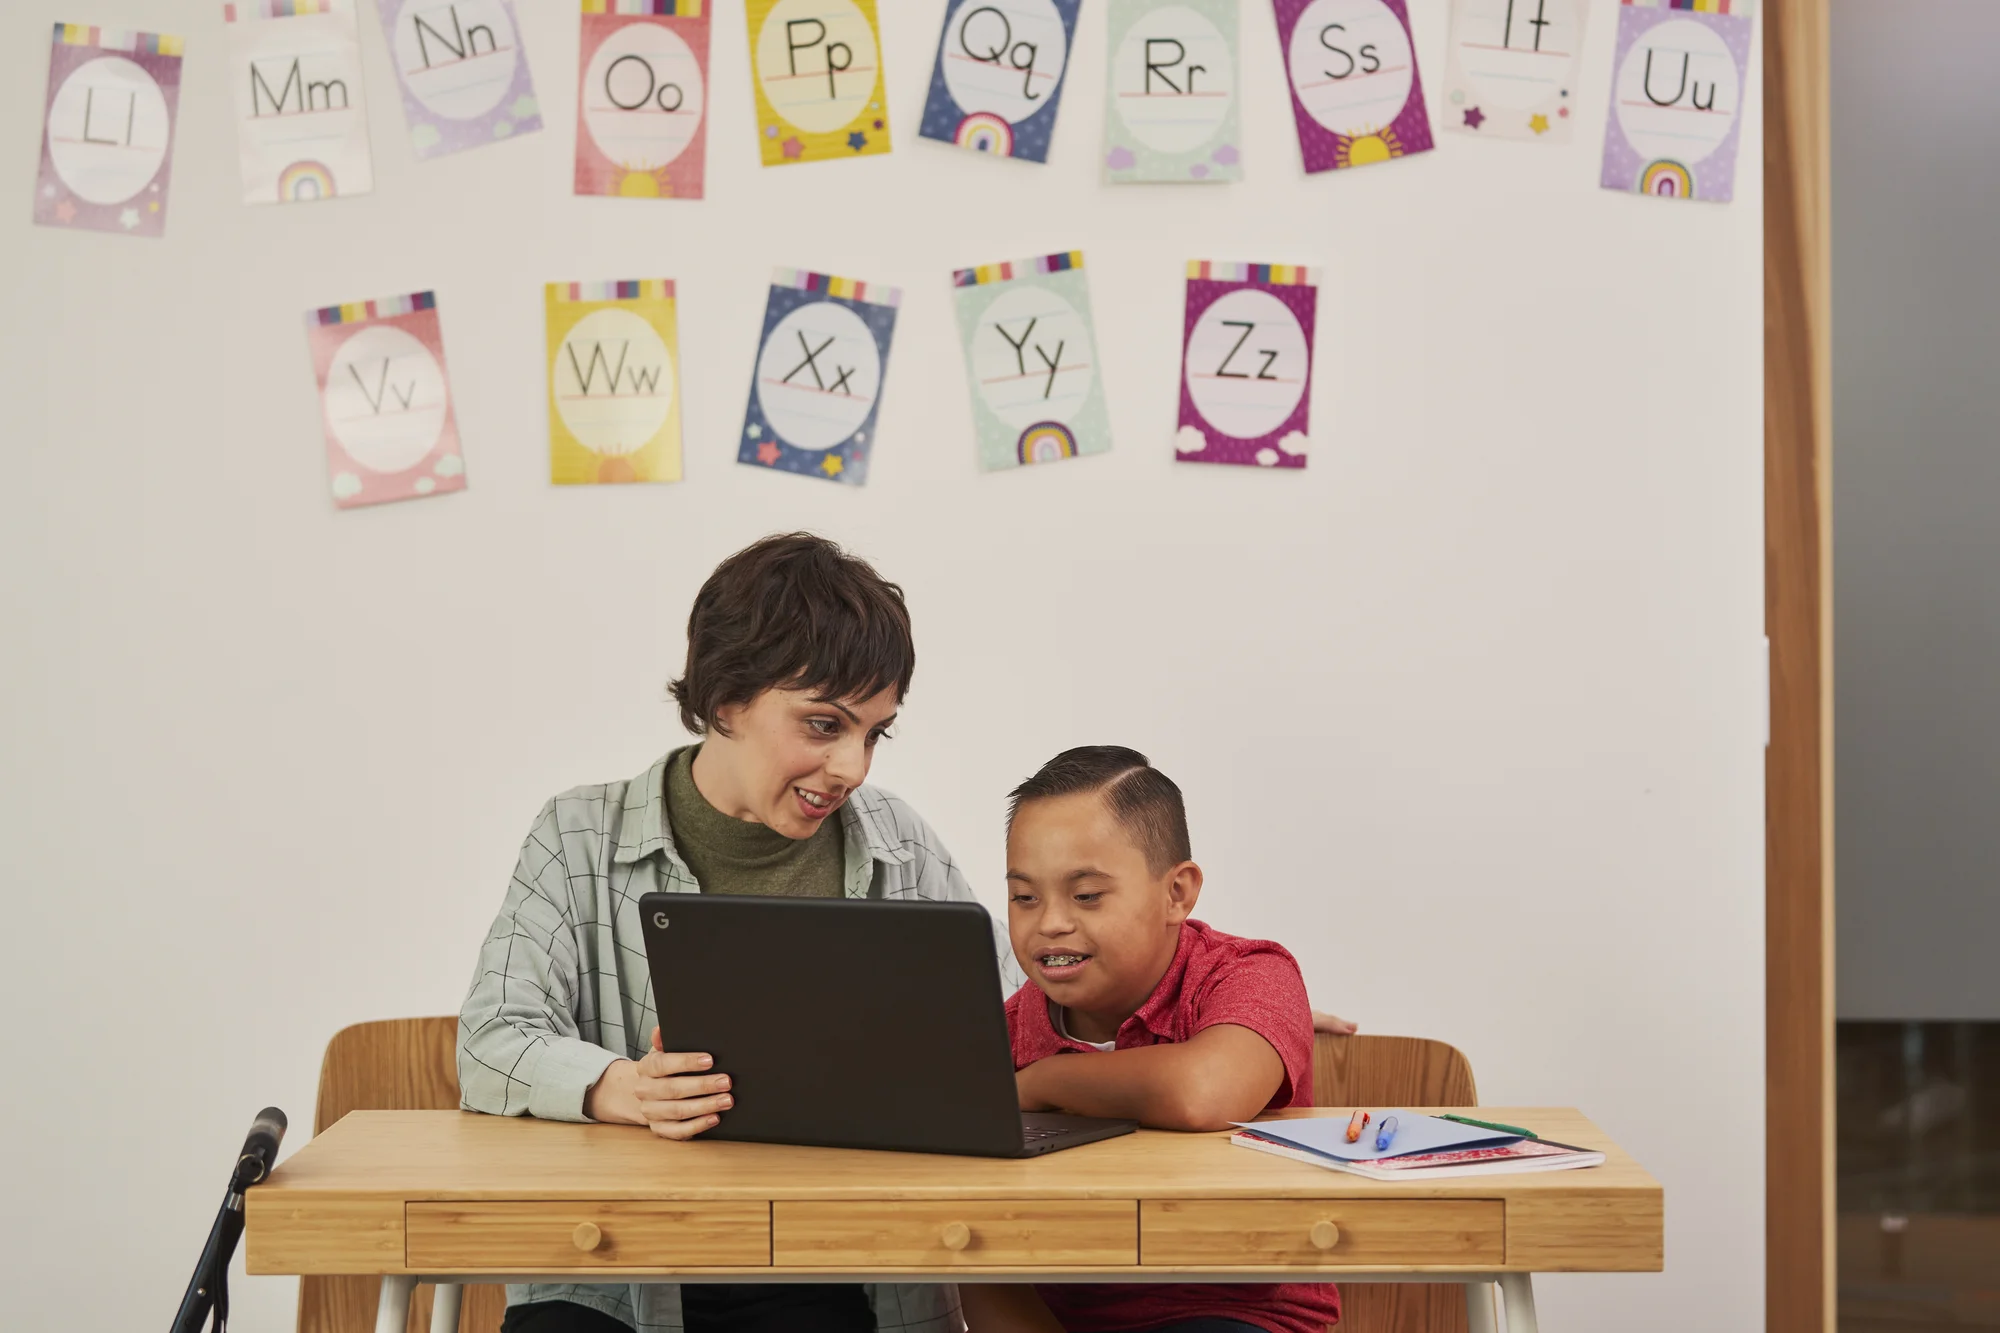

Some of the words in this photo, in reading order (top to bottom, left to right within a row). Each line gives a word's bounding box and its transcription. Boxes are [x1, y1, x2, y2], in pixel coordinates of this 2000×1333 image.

[413, 4, 498, 68] Nn
[786, 18, 853, 99] Pp
[960, 7, 1040, 100] Qq
[1320, 24, 1381, 79] Ss
[250, 57, 349, 117] Mm
[604, 54, 684, 112] Oo
[1145, 38, 1207, 95] Rr
[1643, 48, 1716, 111] Uu
[83, 86, 135, 146] Ll
[567, 339, 661, 395] Ww
[782, 330, 855, 396] Xx
[995, 317, 1064, 399] Yy
[1216, 320, 1279, 379] Zz
[348, 357, 416, 414] Vv
[653, 912, 669, 929] G
